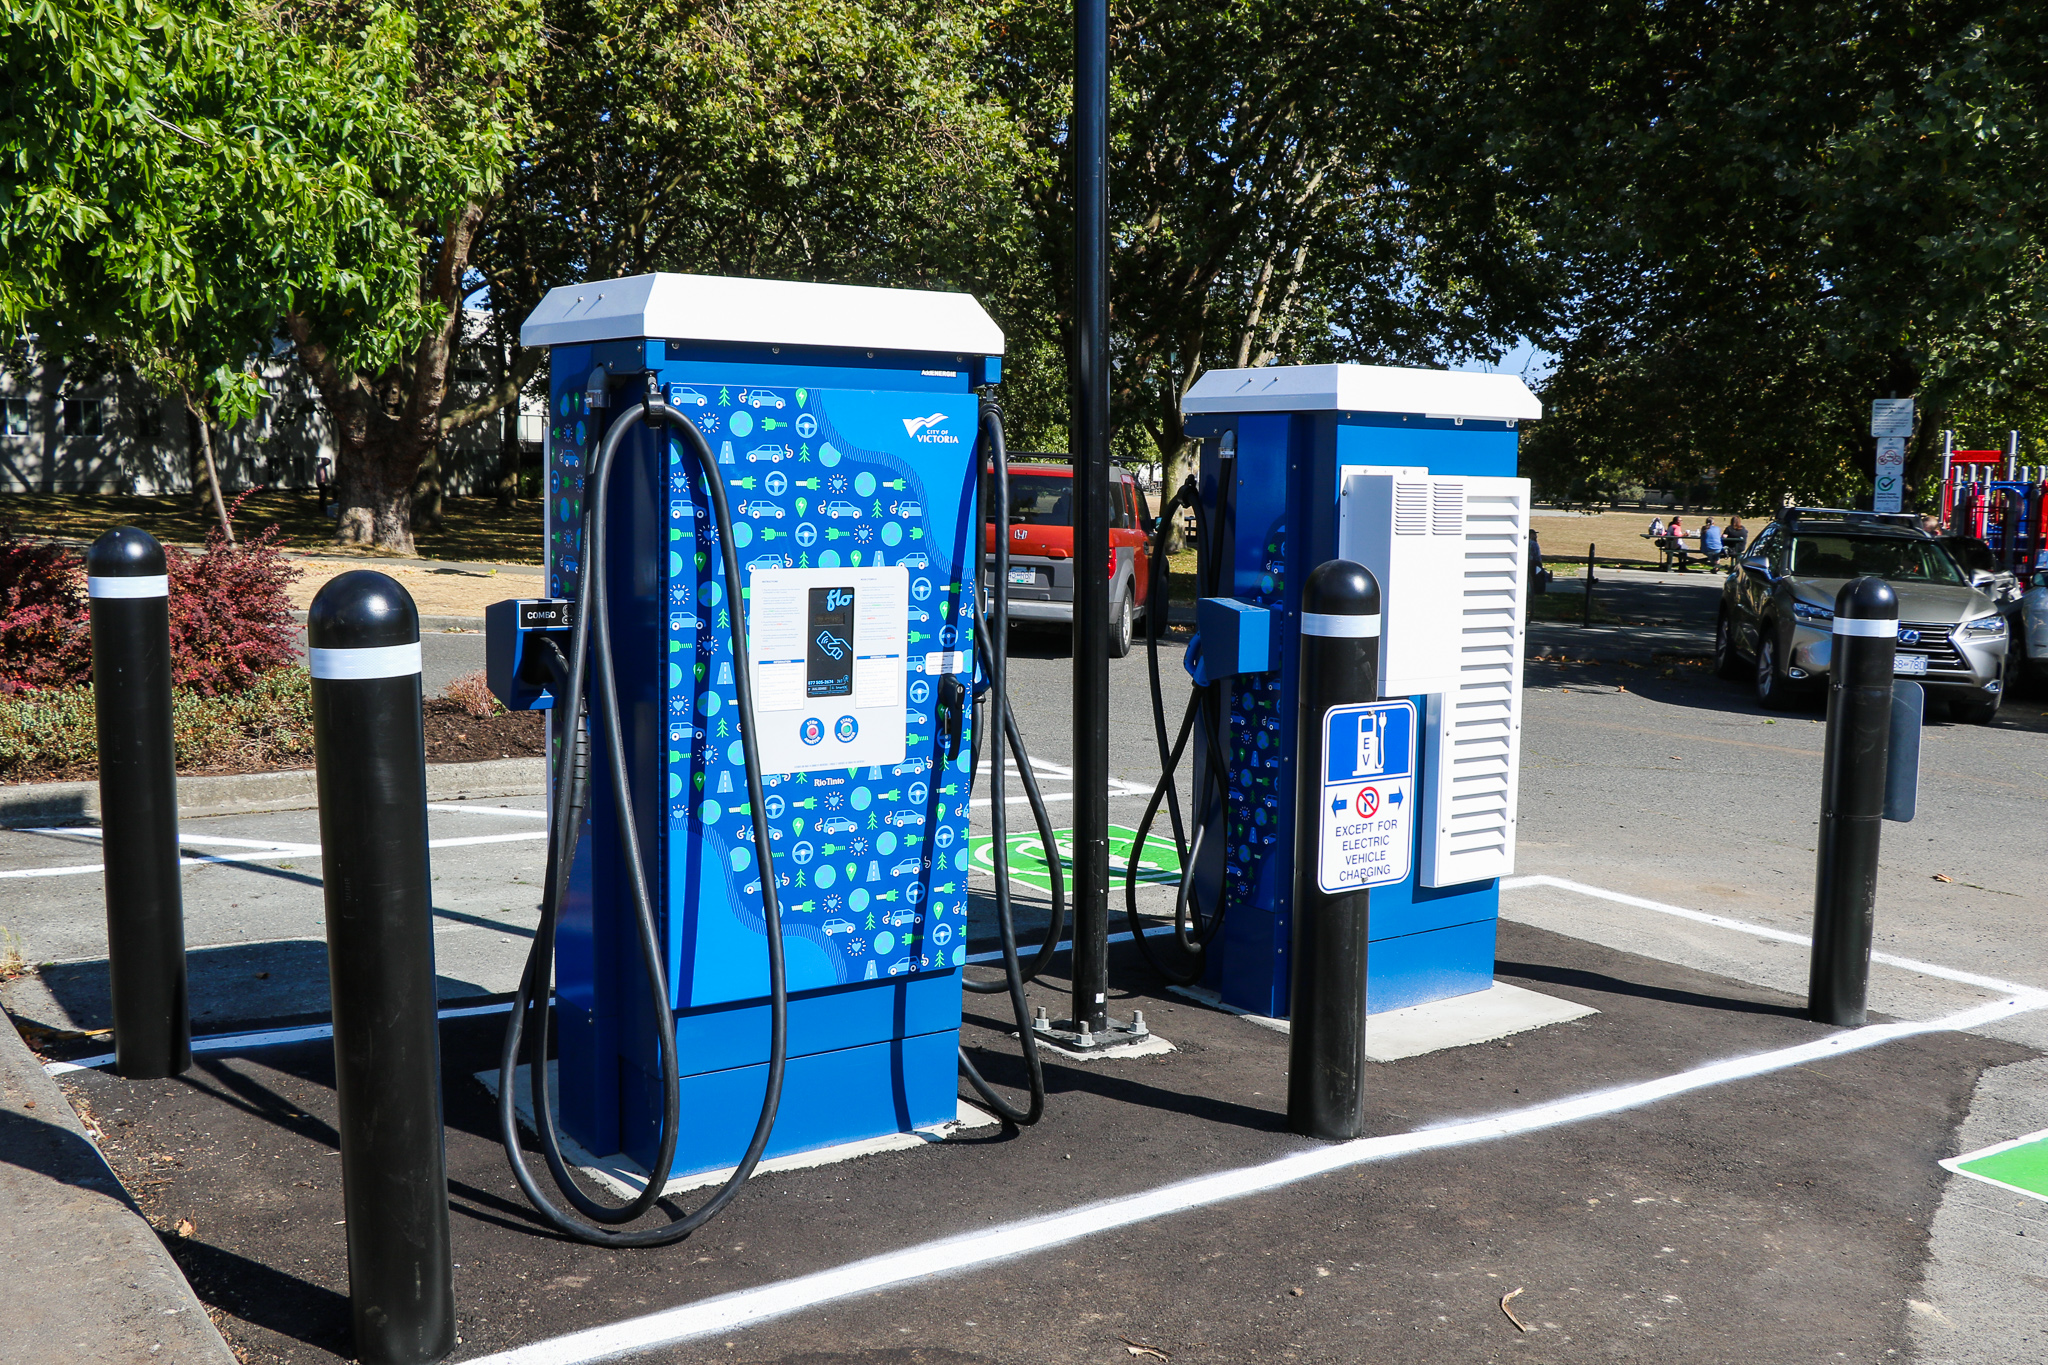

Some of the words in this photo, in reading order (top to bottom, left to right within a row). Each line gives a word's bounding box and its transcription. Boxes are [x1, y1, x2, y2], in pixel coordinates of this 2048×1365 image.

[916, 434, 959, 444] VICTORIA
[826, 588, 854, 611] flo
[527, 611, 556, 620] COMBO
[1335, 822, 1374, 837] EXCEPT
[1377, 819, 1398, 831] FOR
[1342, 835, 1390, 851] ELECTRIC
[1345, 850, 1386, 865] VEHICLE
[1339, 865, 1391, 881] CHARGING
